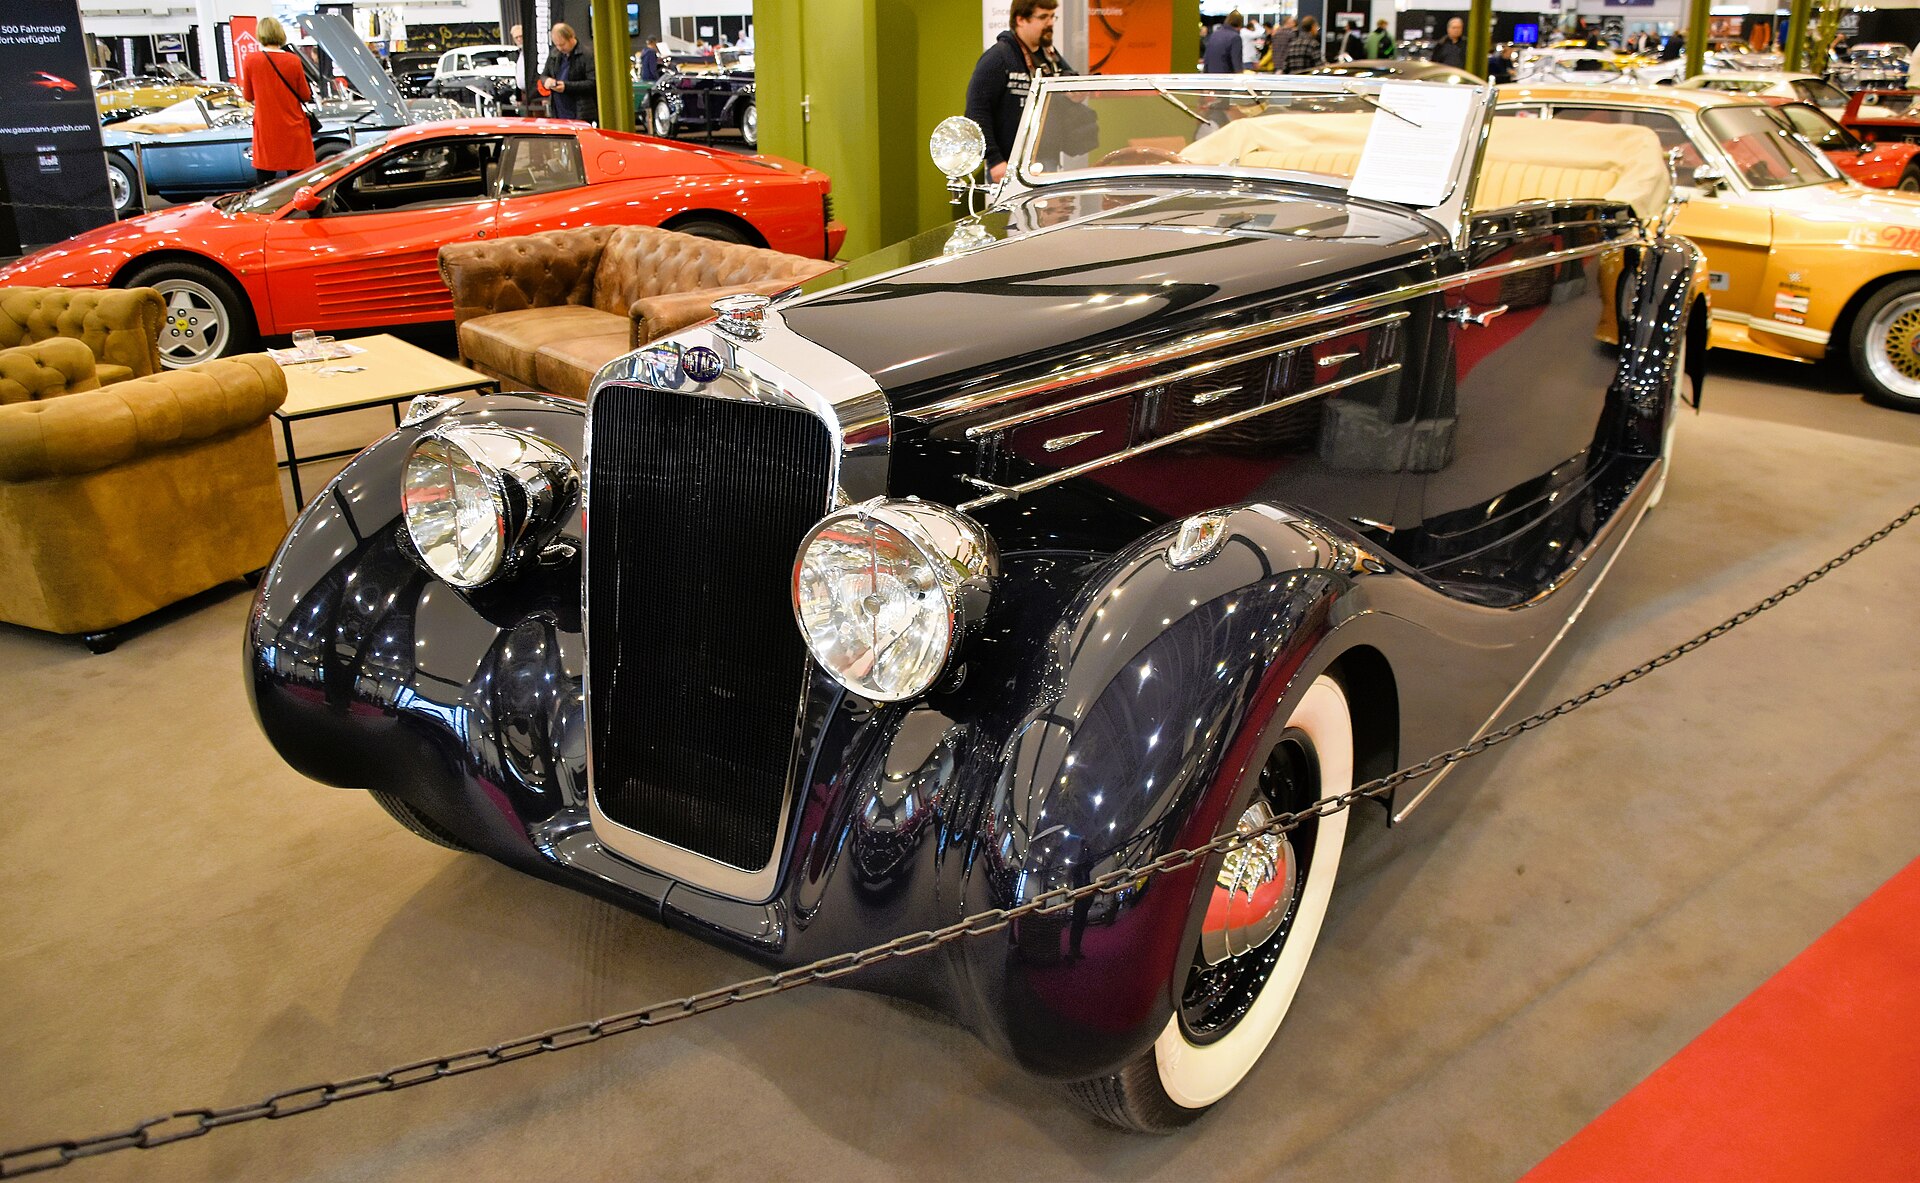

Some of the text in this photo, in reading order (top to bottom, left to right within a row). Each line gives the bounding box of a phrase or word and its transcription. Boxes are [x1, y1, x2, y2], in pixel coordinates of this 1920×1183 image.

[1, 24, 67, 34] 500 Fahrzeuge
[15, 34, 61, 45] verfügbar!
